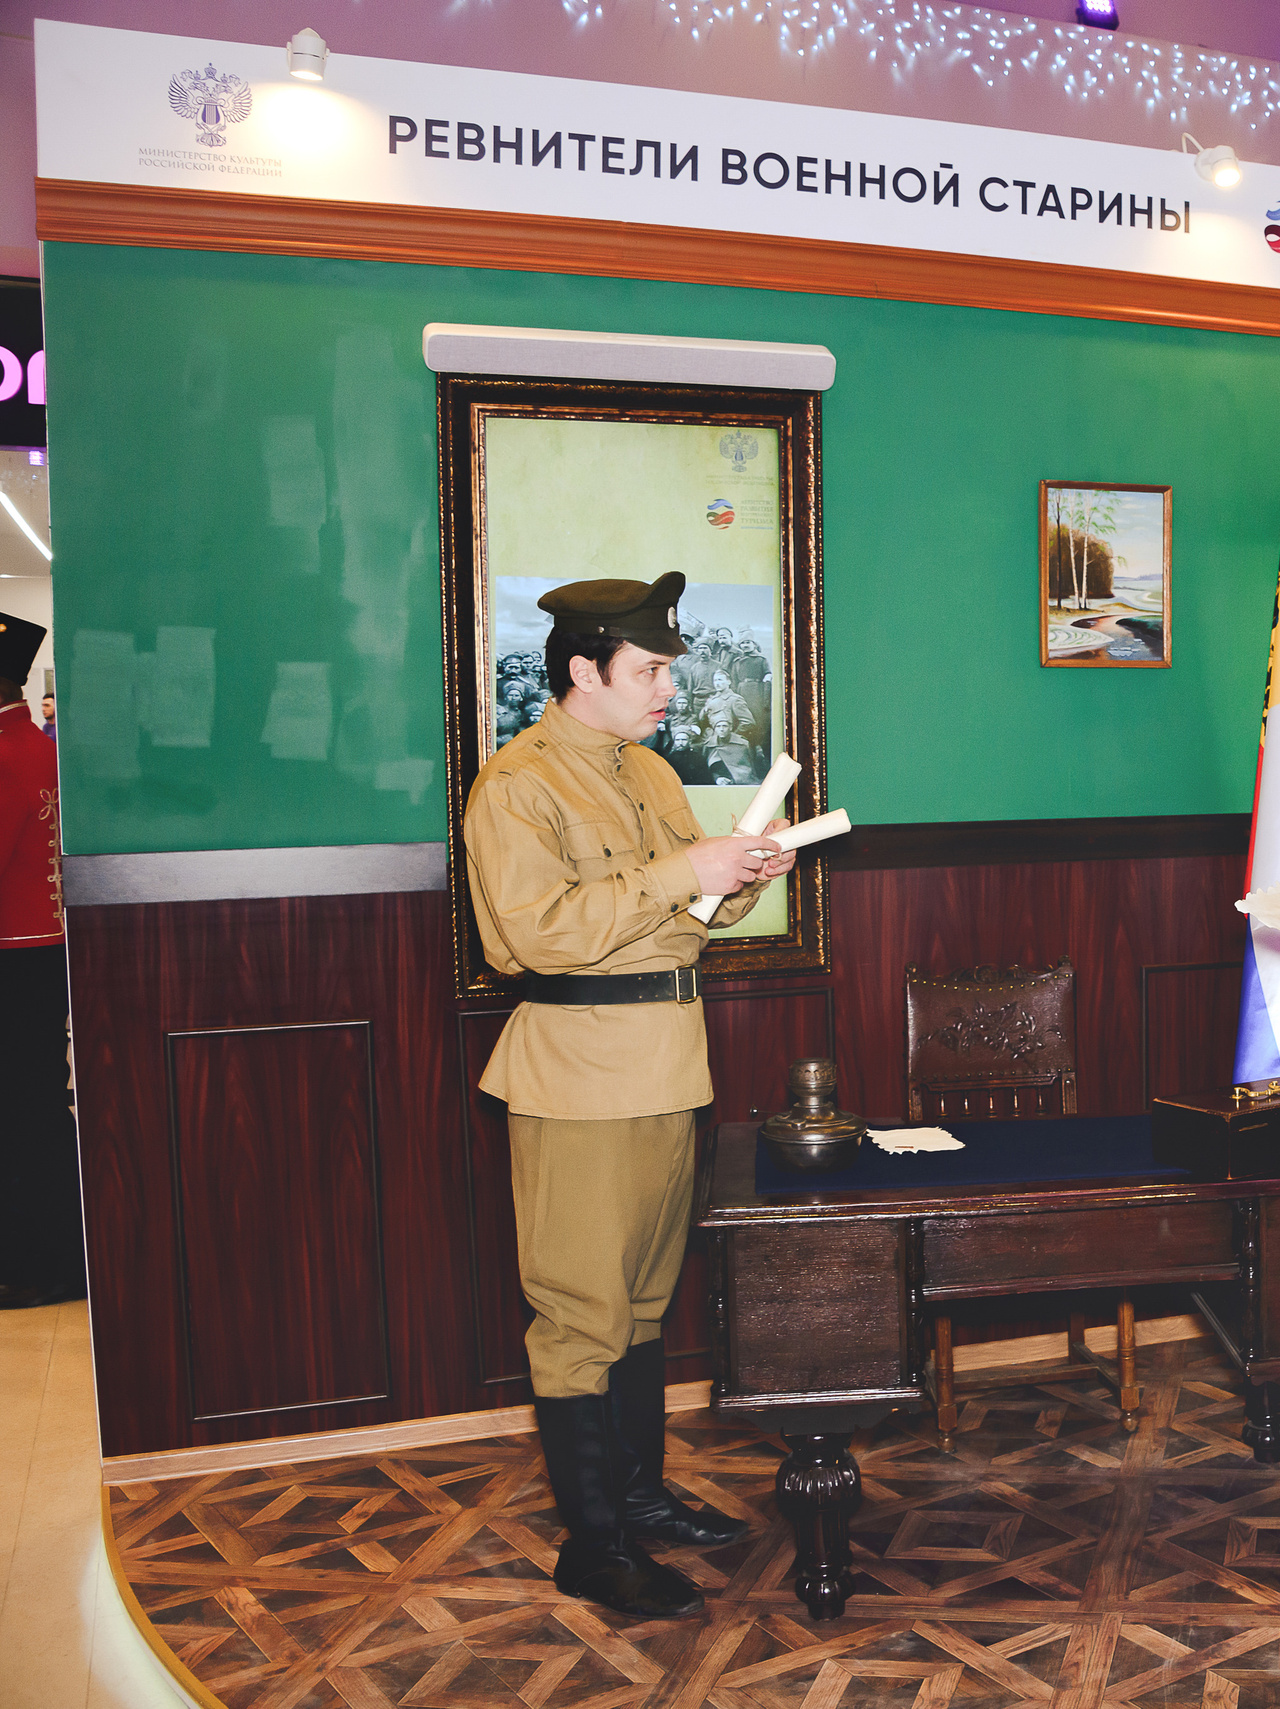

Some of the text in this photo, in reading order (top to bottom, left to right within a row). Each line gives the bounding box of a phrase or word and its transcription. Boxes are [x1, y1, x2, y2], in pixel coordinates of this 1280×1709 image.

[138, 147, 282, 168] МИНИСТЕРСТВО КУЛЬТУРЫ
[138, 157, 283, 178] РОССИЙСКОЙ ФЕДЕРАЦИИ
[388, 114, 1190, 234] РЕВНИТЕЛИ ВОЕННОЙ СТАРИНЫ
